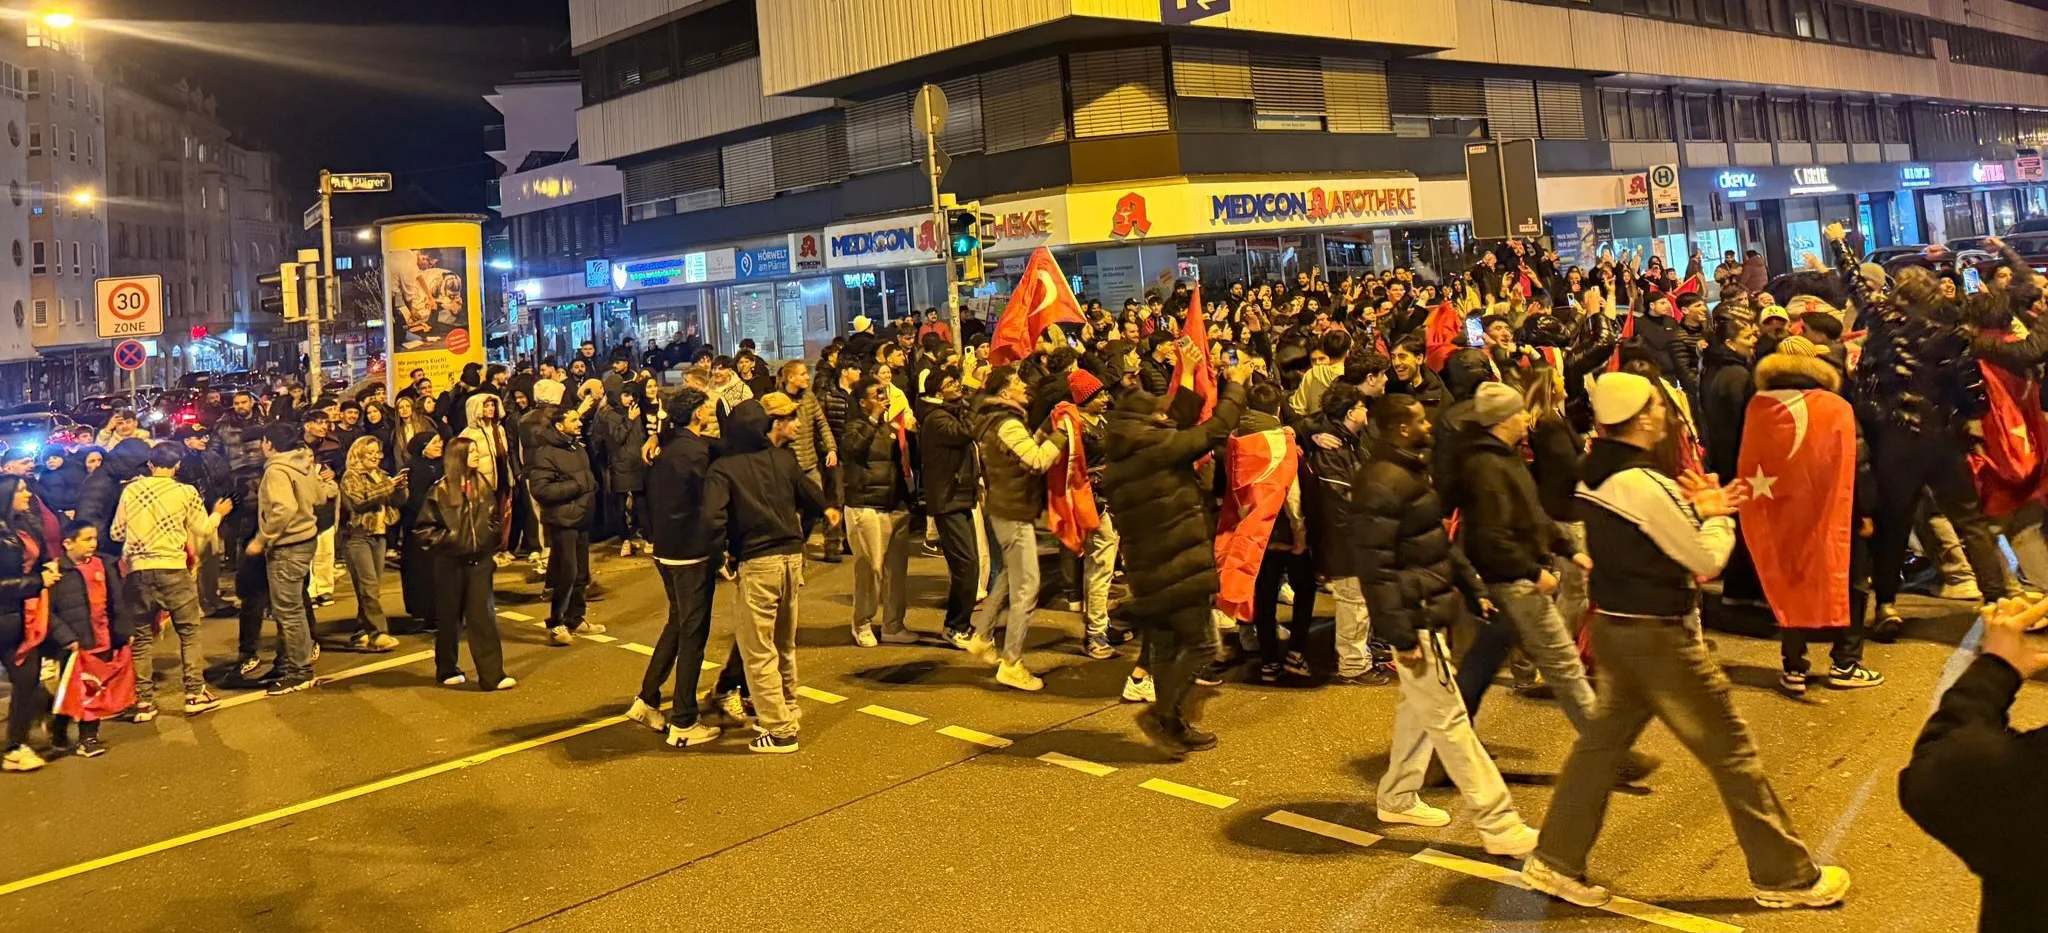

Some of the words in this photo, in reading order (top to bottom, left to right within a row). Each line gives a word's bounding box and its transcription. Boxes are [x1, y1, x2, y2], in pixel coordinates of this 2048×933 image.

[1658, 170, 1669, 183] H
[1212, 192, 1307, 219] MEDICON
[1331, 188, 1416, 213] APOTHEKE
[832, 226, 914, 257] MEDICON
[757, 249, 787, 261] HÖRWELT
[768, 260, 788, 270] Plärrer
[117, 292, 141, 310] 30
[114, 321, 145, 333] ZONE
